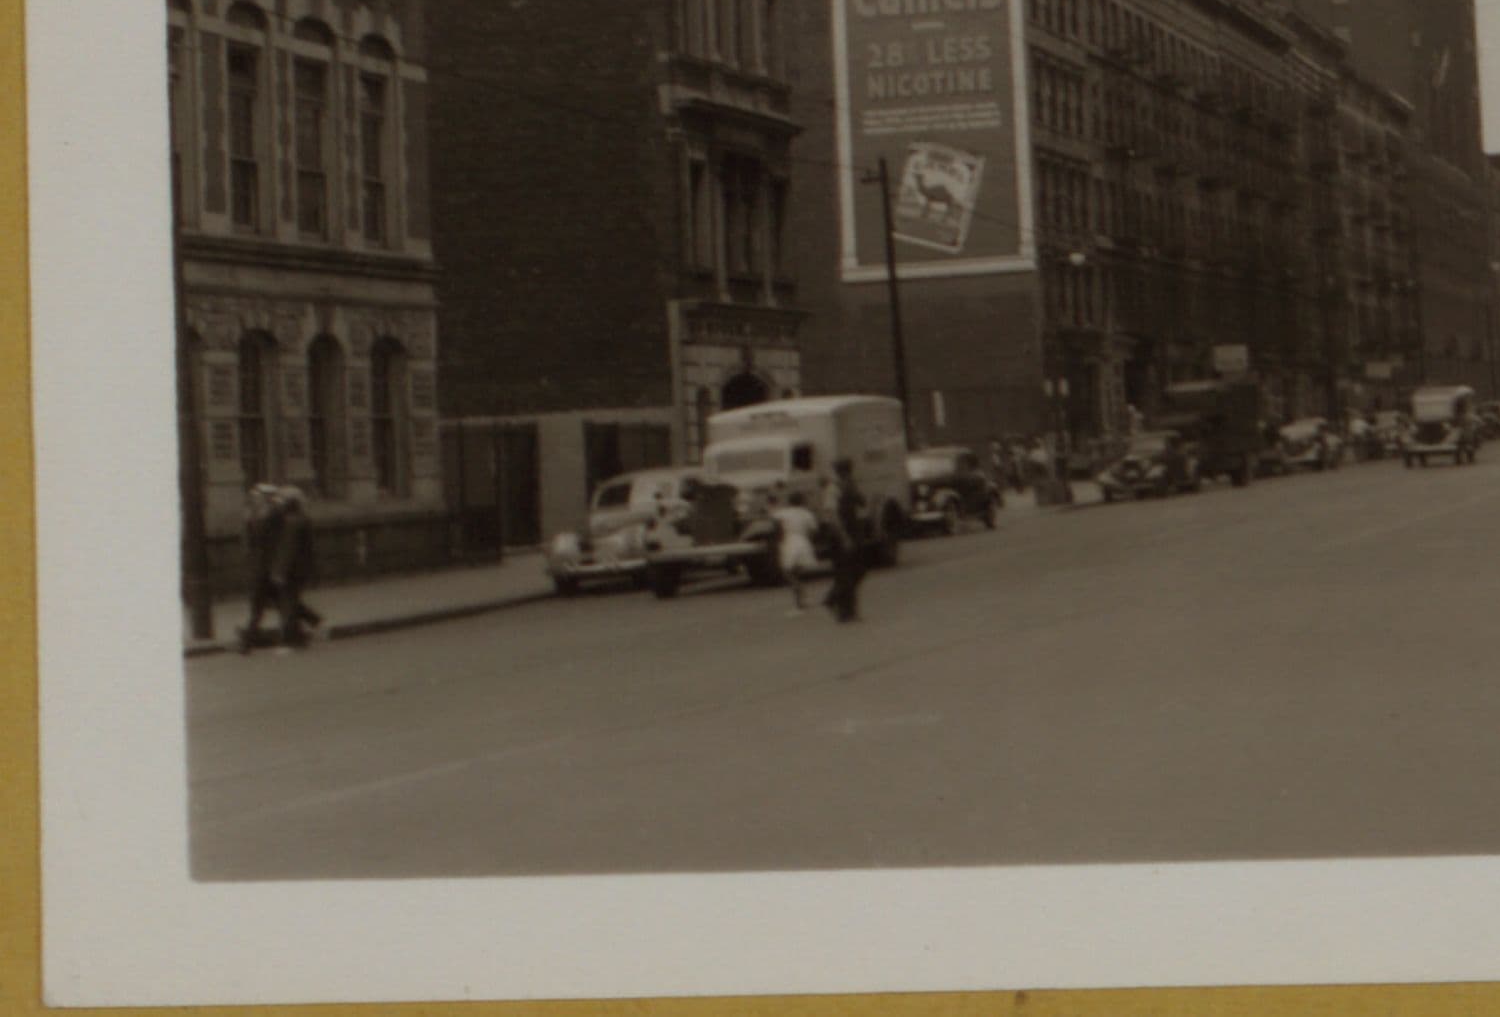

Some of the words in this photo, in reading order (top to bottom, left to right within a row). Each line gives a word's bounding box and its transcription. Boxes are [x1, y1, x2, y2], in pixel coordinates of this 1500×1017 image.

[866, 40, 918, 68] 28
[923, 35, 992, 64] LESS
[866, 67, 992, 99] NICOTINE
